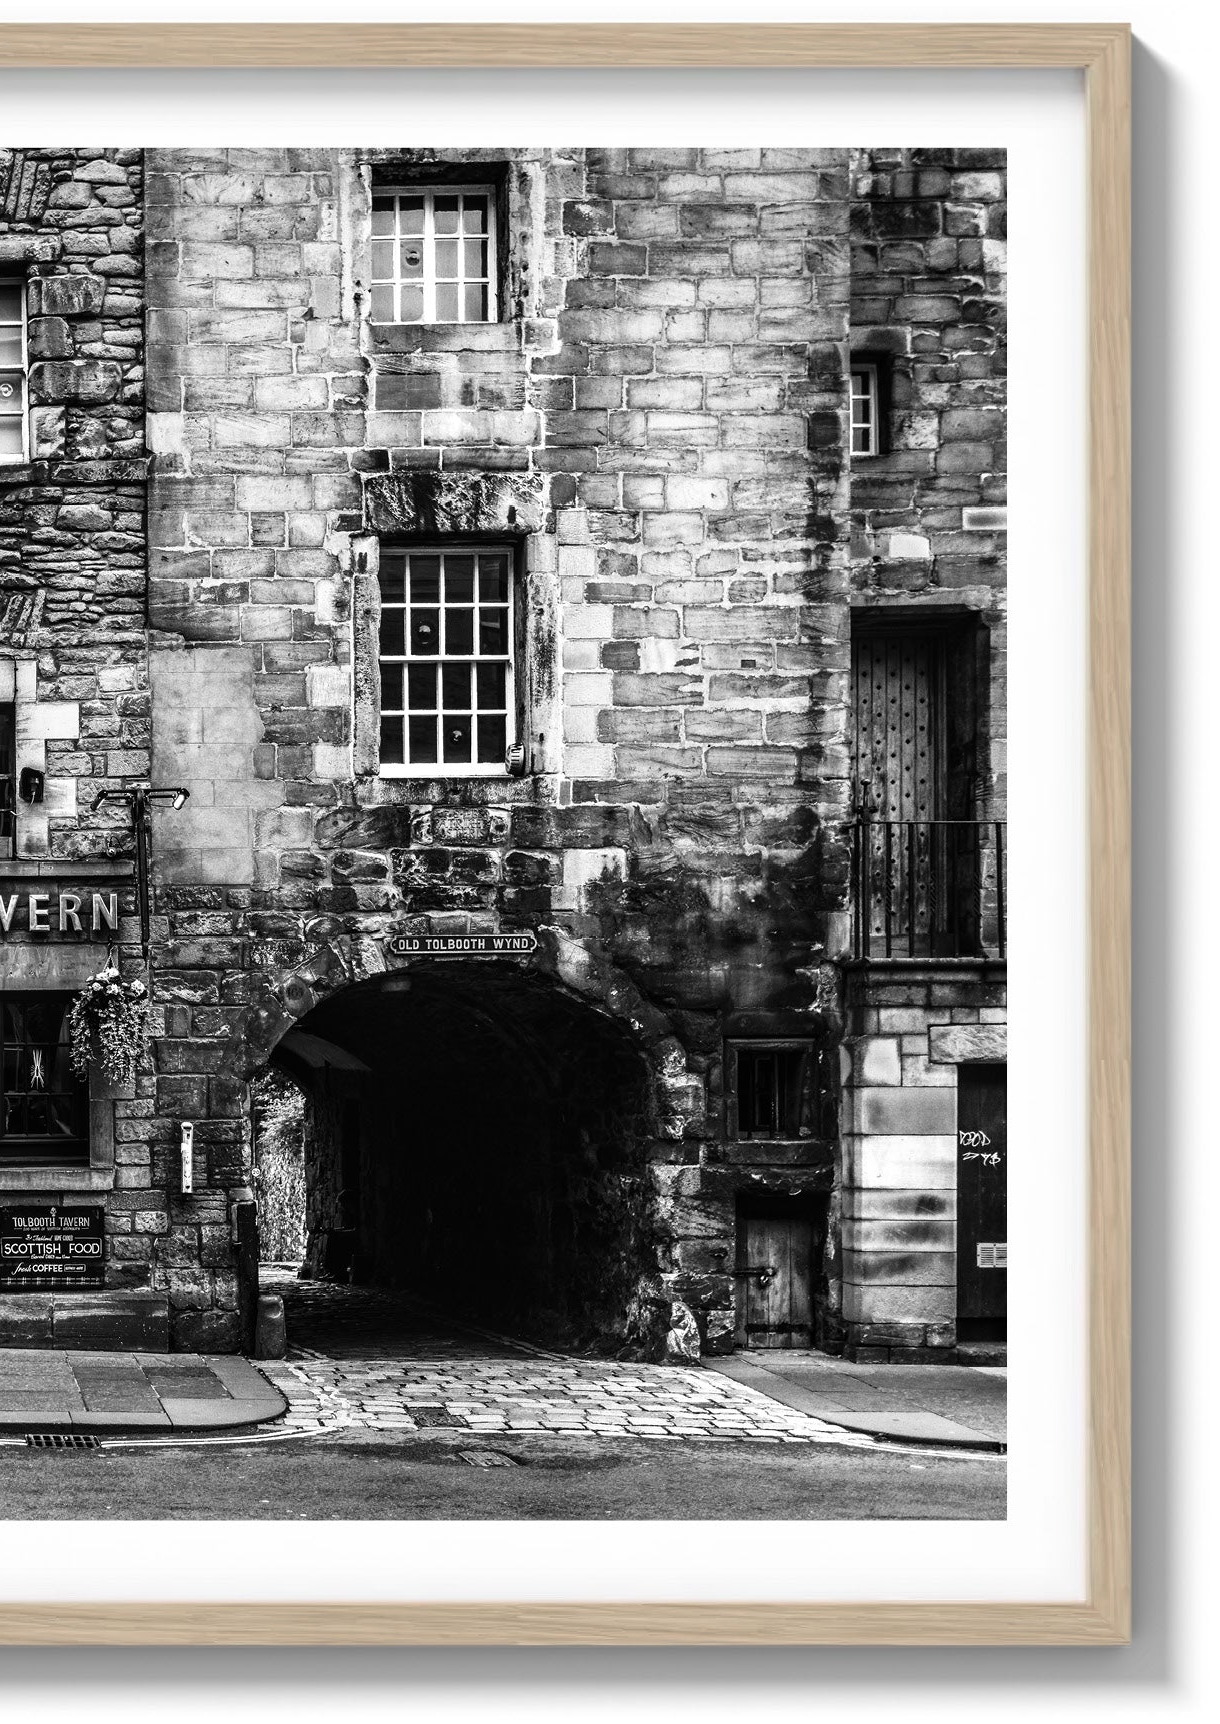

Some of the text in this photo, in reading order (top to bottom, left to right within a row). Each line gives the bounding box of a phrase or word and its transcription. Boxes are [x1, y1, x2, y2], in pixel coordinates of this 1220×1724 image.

[398, 938, 529, 950] OLD TOLBOOTH WYND
[12, 1216, 90, 1227] TOLBOOTH TAVERN
[4, 1243, 100, 1255] SCOTTISH FOOD
[32, 1264, 63, 1272] COFFEE
